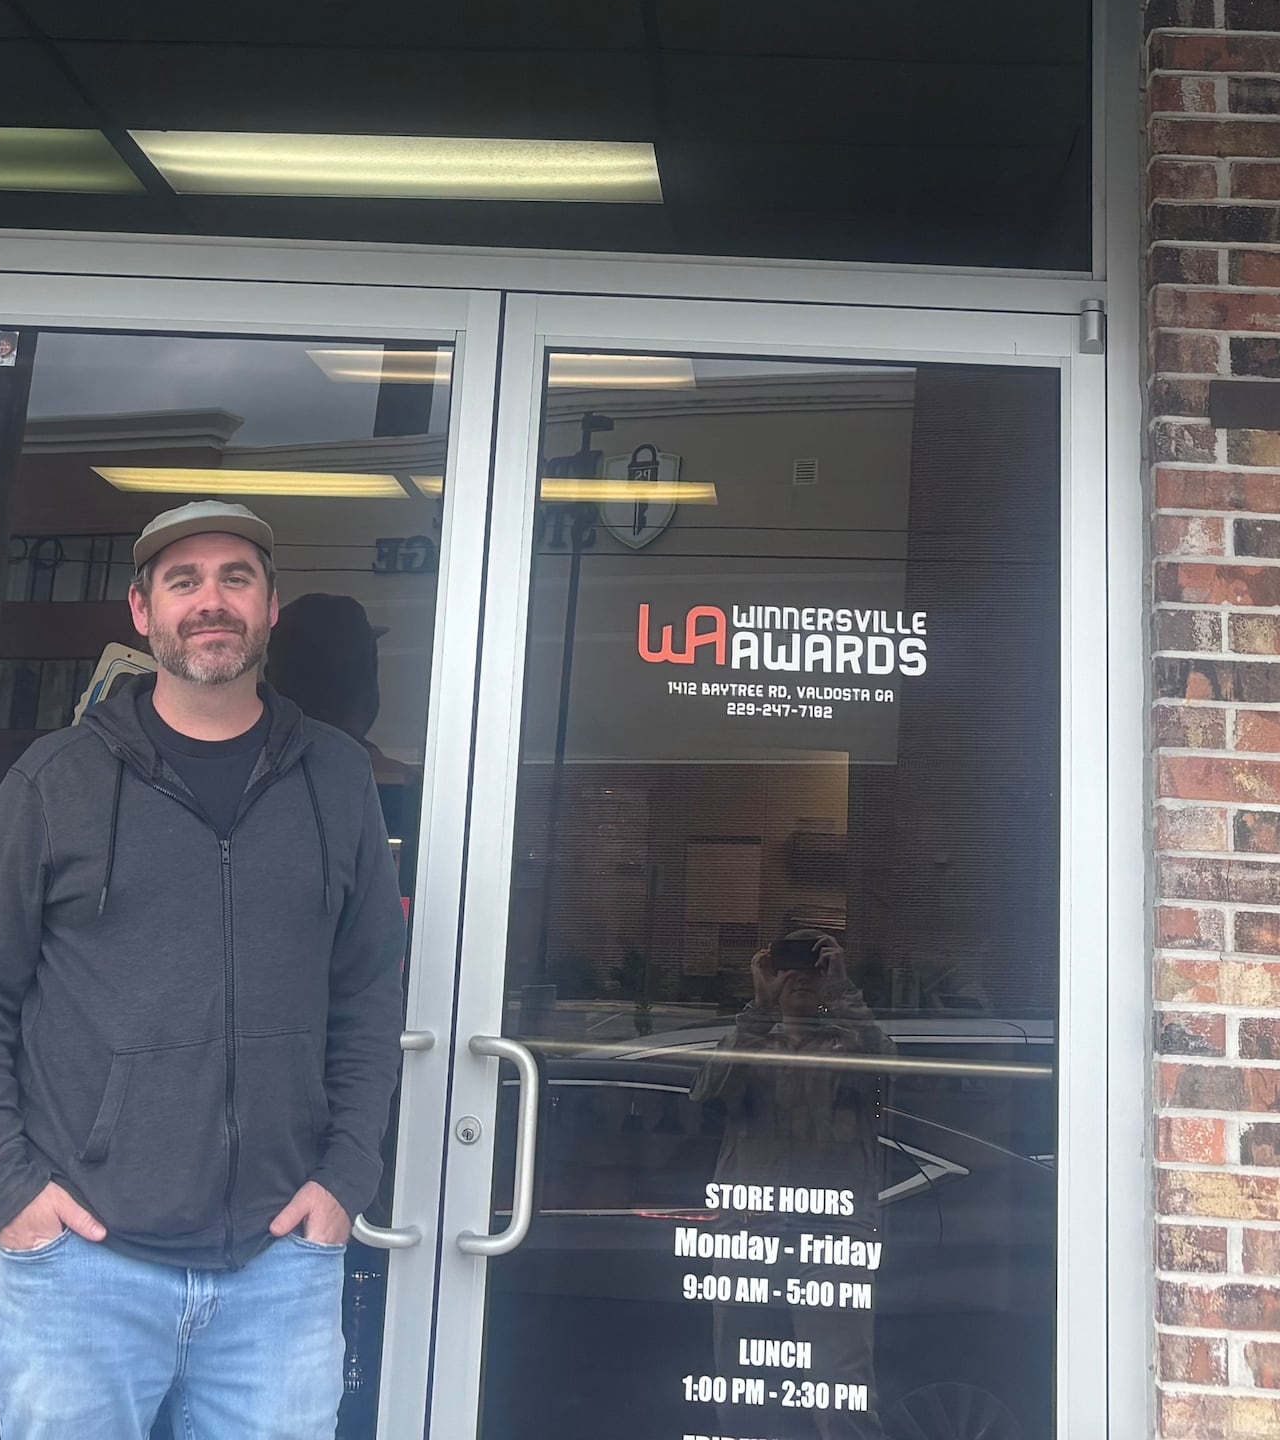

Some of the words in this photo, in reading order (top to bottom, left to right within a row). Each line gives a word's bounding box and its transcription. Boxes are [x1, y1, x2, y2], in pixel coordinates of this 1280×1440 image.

[638, 604, 727, 665] WA
[732, 605, 927, 635] WINNERSVILLE
[731, 631, 927, 676] AWARDS
[668, 681, 697, 695] 1412
[702, 683, 763, 697] BAYTREE
[768, 685, 791, 700] RD,
[797, 686, 870, 701] VALDOSTA
[875, 689, 894, 702] GA
[727, 702, 833, 719] 229-247-7182
[705, 1183, 774, 1211] STORE
[779, 1187, 854, 1216] HOURS
[674, 1227, 779, 1264] Monday
[784, 1246, 794, 1254] -
[800, 1234, 882, 1270] Friday
[683, 1273, 731, 1301] 9:00
[735, 1277, 769, 1303] AM
[786, 1278, 834, 1307] 5:00
[839, 1282, 872, 1309] PM
[739, 1338, 812, 1369] LUNCH
[682, 1375, 727, 1403] 1:00
[732, 1378, 764, 1405] PM
[781, 1380, 829, 1409] 2:30
[834, 1383, 868, 1411] PM
